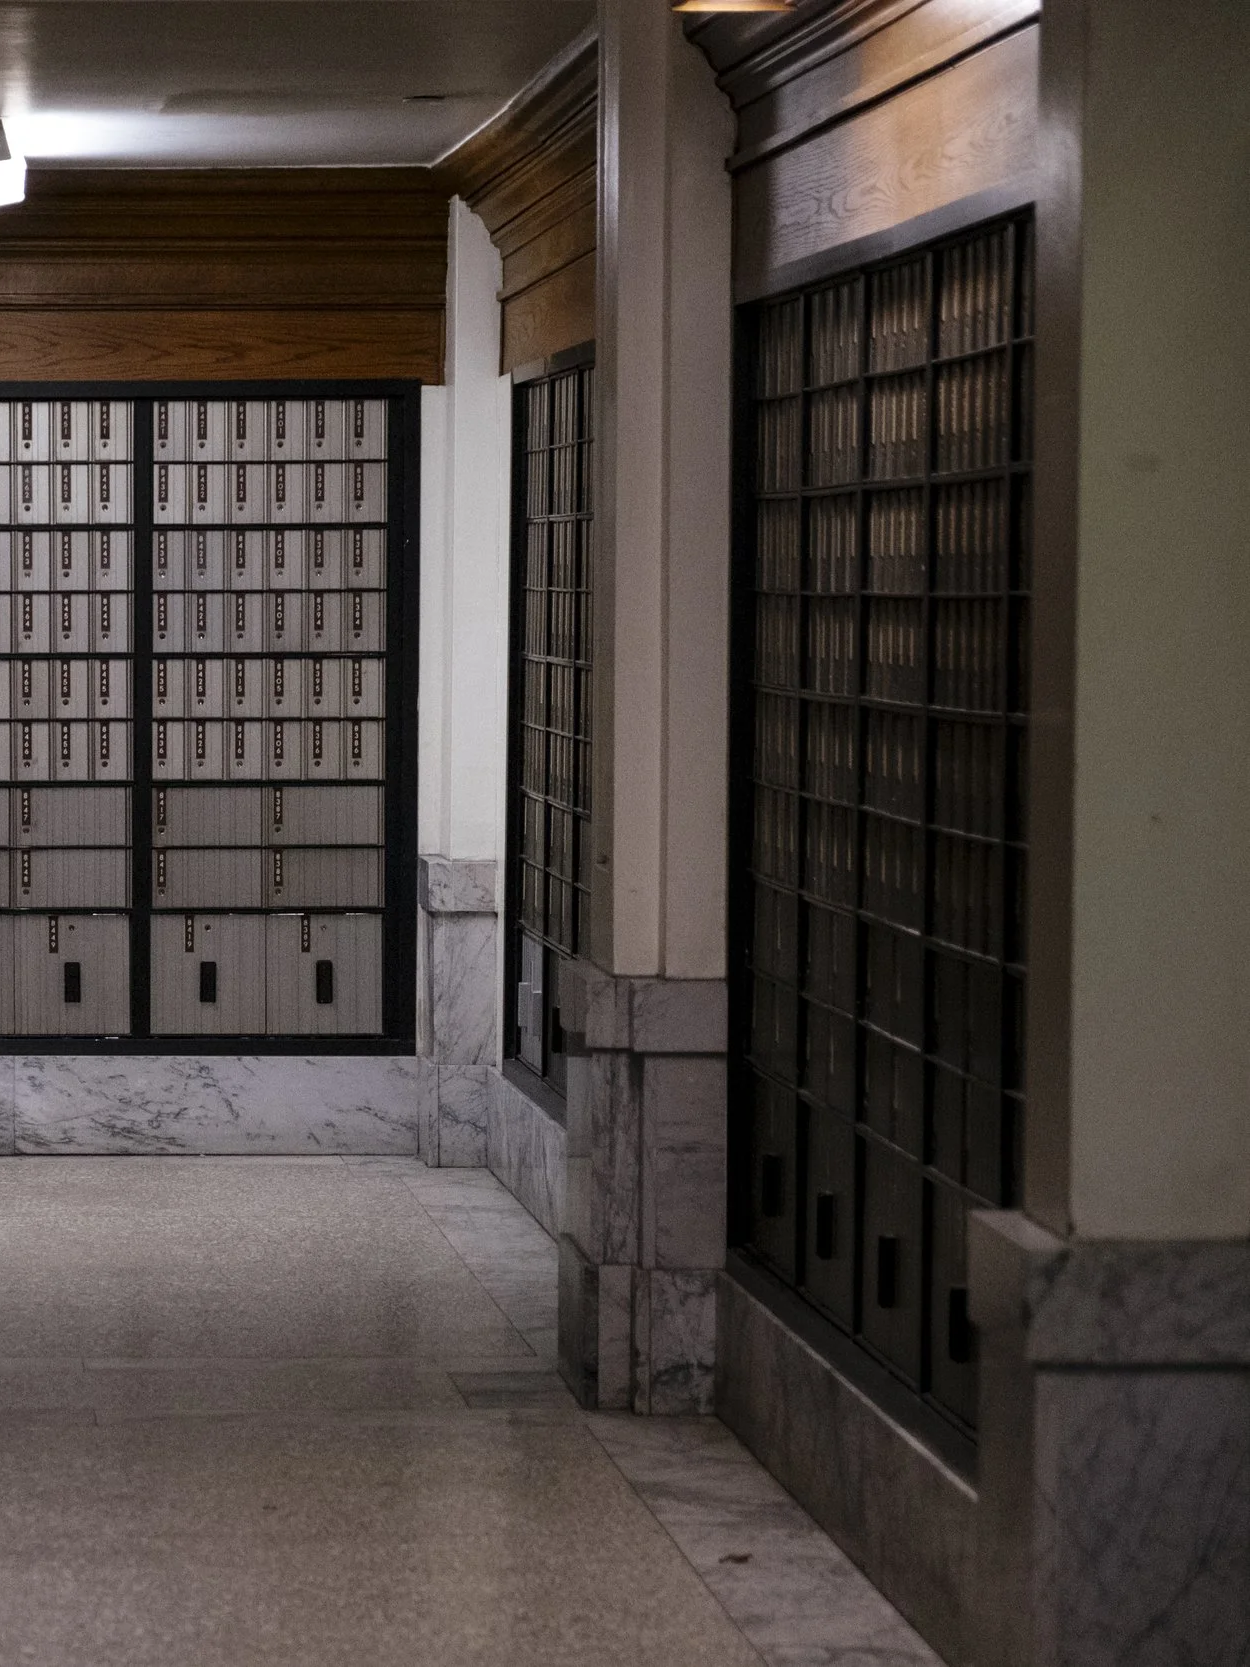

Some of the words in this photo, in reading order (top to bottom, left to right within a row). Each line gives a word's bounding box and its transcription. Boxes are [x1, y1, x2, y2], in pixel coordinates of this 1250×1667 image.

[159, 406, 167, 435] 8431
[198, 406, 206, 435] 8421
[316, 405, 324, 434] 8391
[23, 469, 31, 499] 8462
[159, 468, 167, 498] 8432
[62, 535, 70, 565] 8453
[158, 535, 166, 564] 8433
[62, 598, 70, 627] 8454
[158, 597, 166, 626] 8434
[100, 663, 108, 693] 8445
[236, 663, 244, 693] 8415
[196, 725, 204, 754] 8426
[22, 854, 30, 883] 8448
